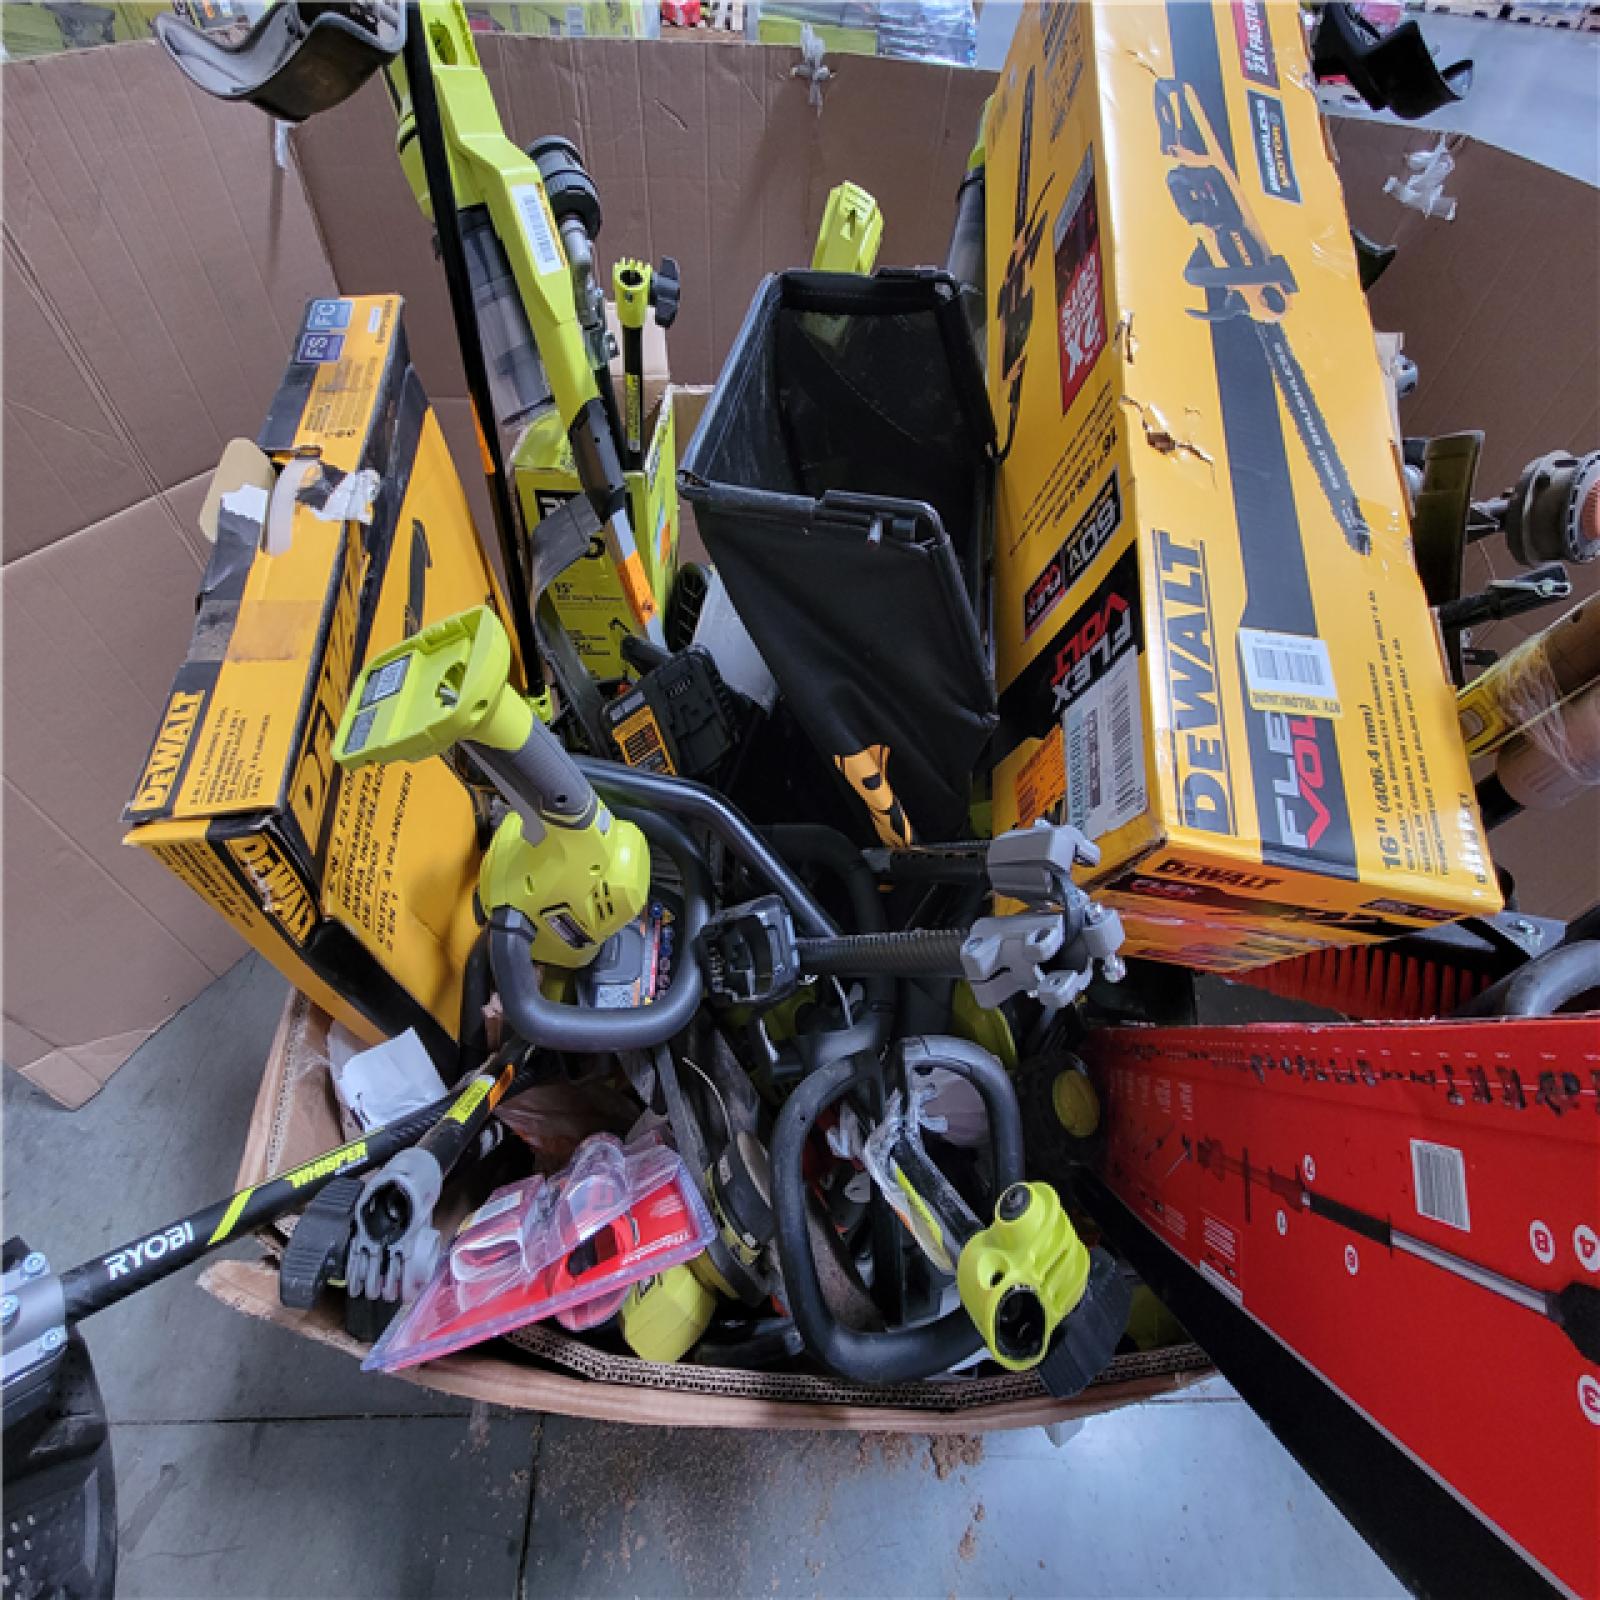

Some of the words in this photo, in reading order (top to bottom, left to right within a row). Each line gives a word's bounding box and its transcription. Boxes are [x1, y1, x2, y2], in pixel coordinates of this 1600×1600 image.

[306, 335, 329, 359] FS
[318, 302, 337, 327] FC
[1050, 606, 1132, 713] FLEX
[1052, 592, 1129, 687] VOLT
[1160, 531, 1233, 836] DEWALT
[130, 689, 206, 812] DEWALT
[1264, 710, 1312, 849] FLE
[1289, 713, 1331, 850] VOL
[103, 1221, 195, 1281] RYOBI
